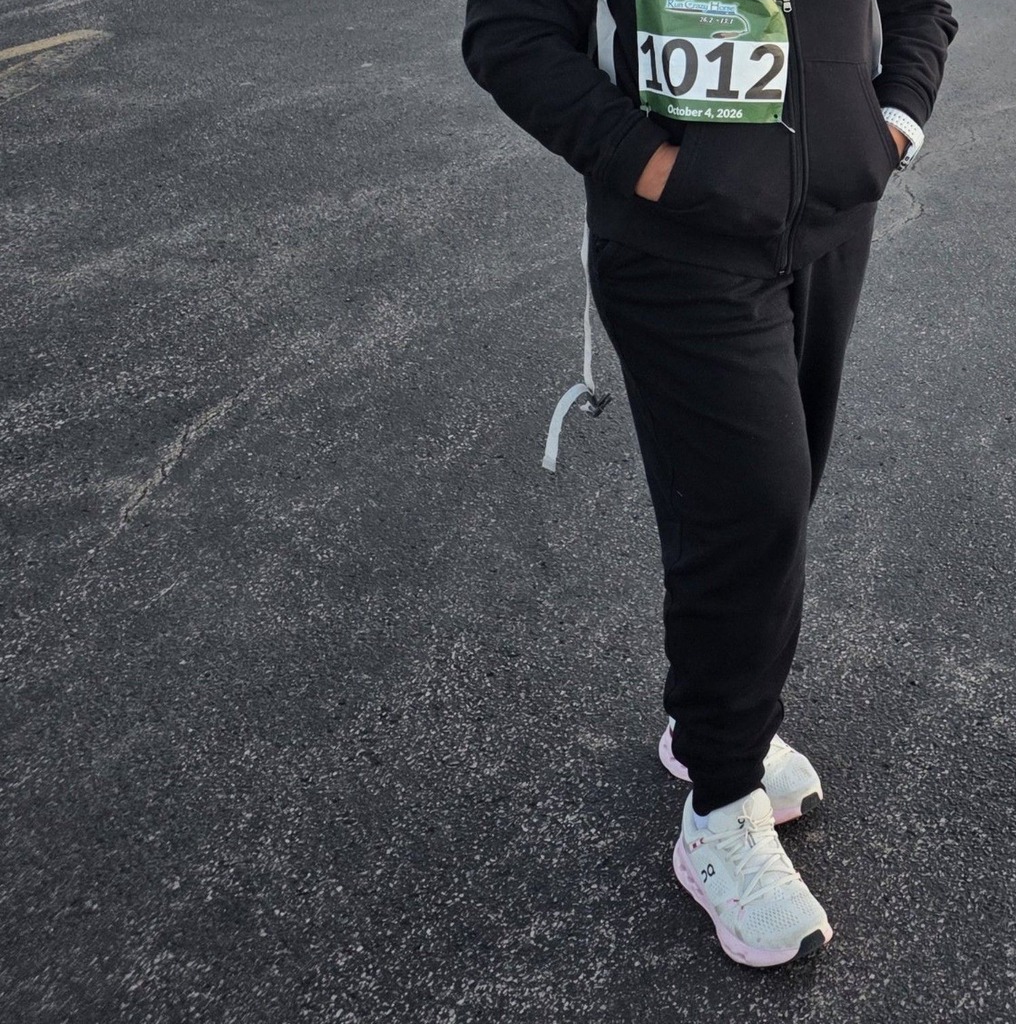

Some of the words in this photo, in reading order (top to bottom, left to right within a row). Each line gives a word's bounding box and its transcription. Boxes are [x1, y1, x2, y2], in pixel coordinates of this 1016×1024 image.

[667, 0, 683, 8] Run
[684, 0, 708, 10] Crazy
[710, 1, 735, 12] Horse
[640, 35, 785, 100] 1012
[667, 104, 703, 117] October
[704, 108, 715, 119] 4,
[716, 109, 743, 118] 2026
